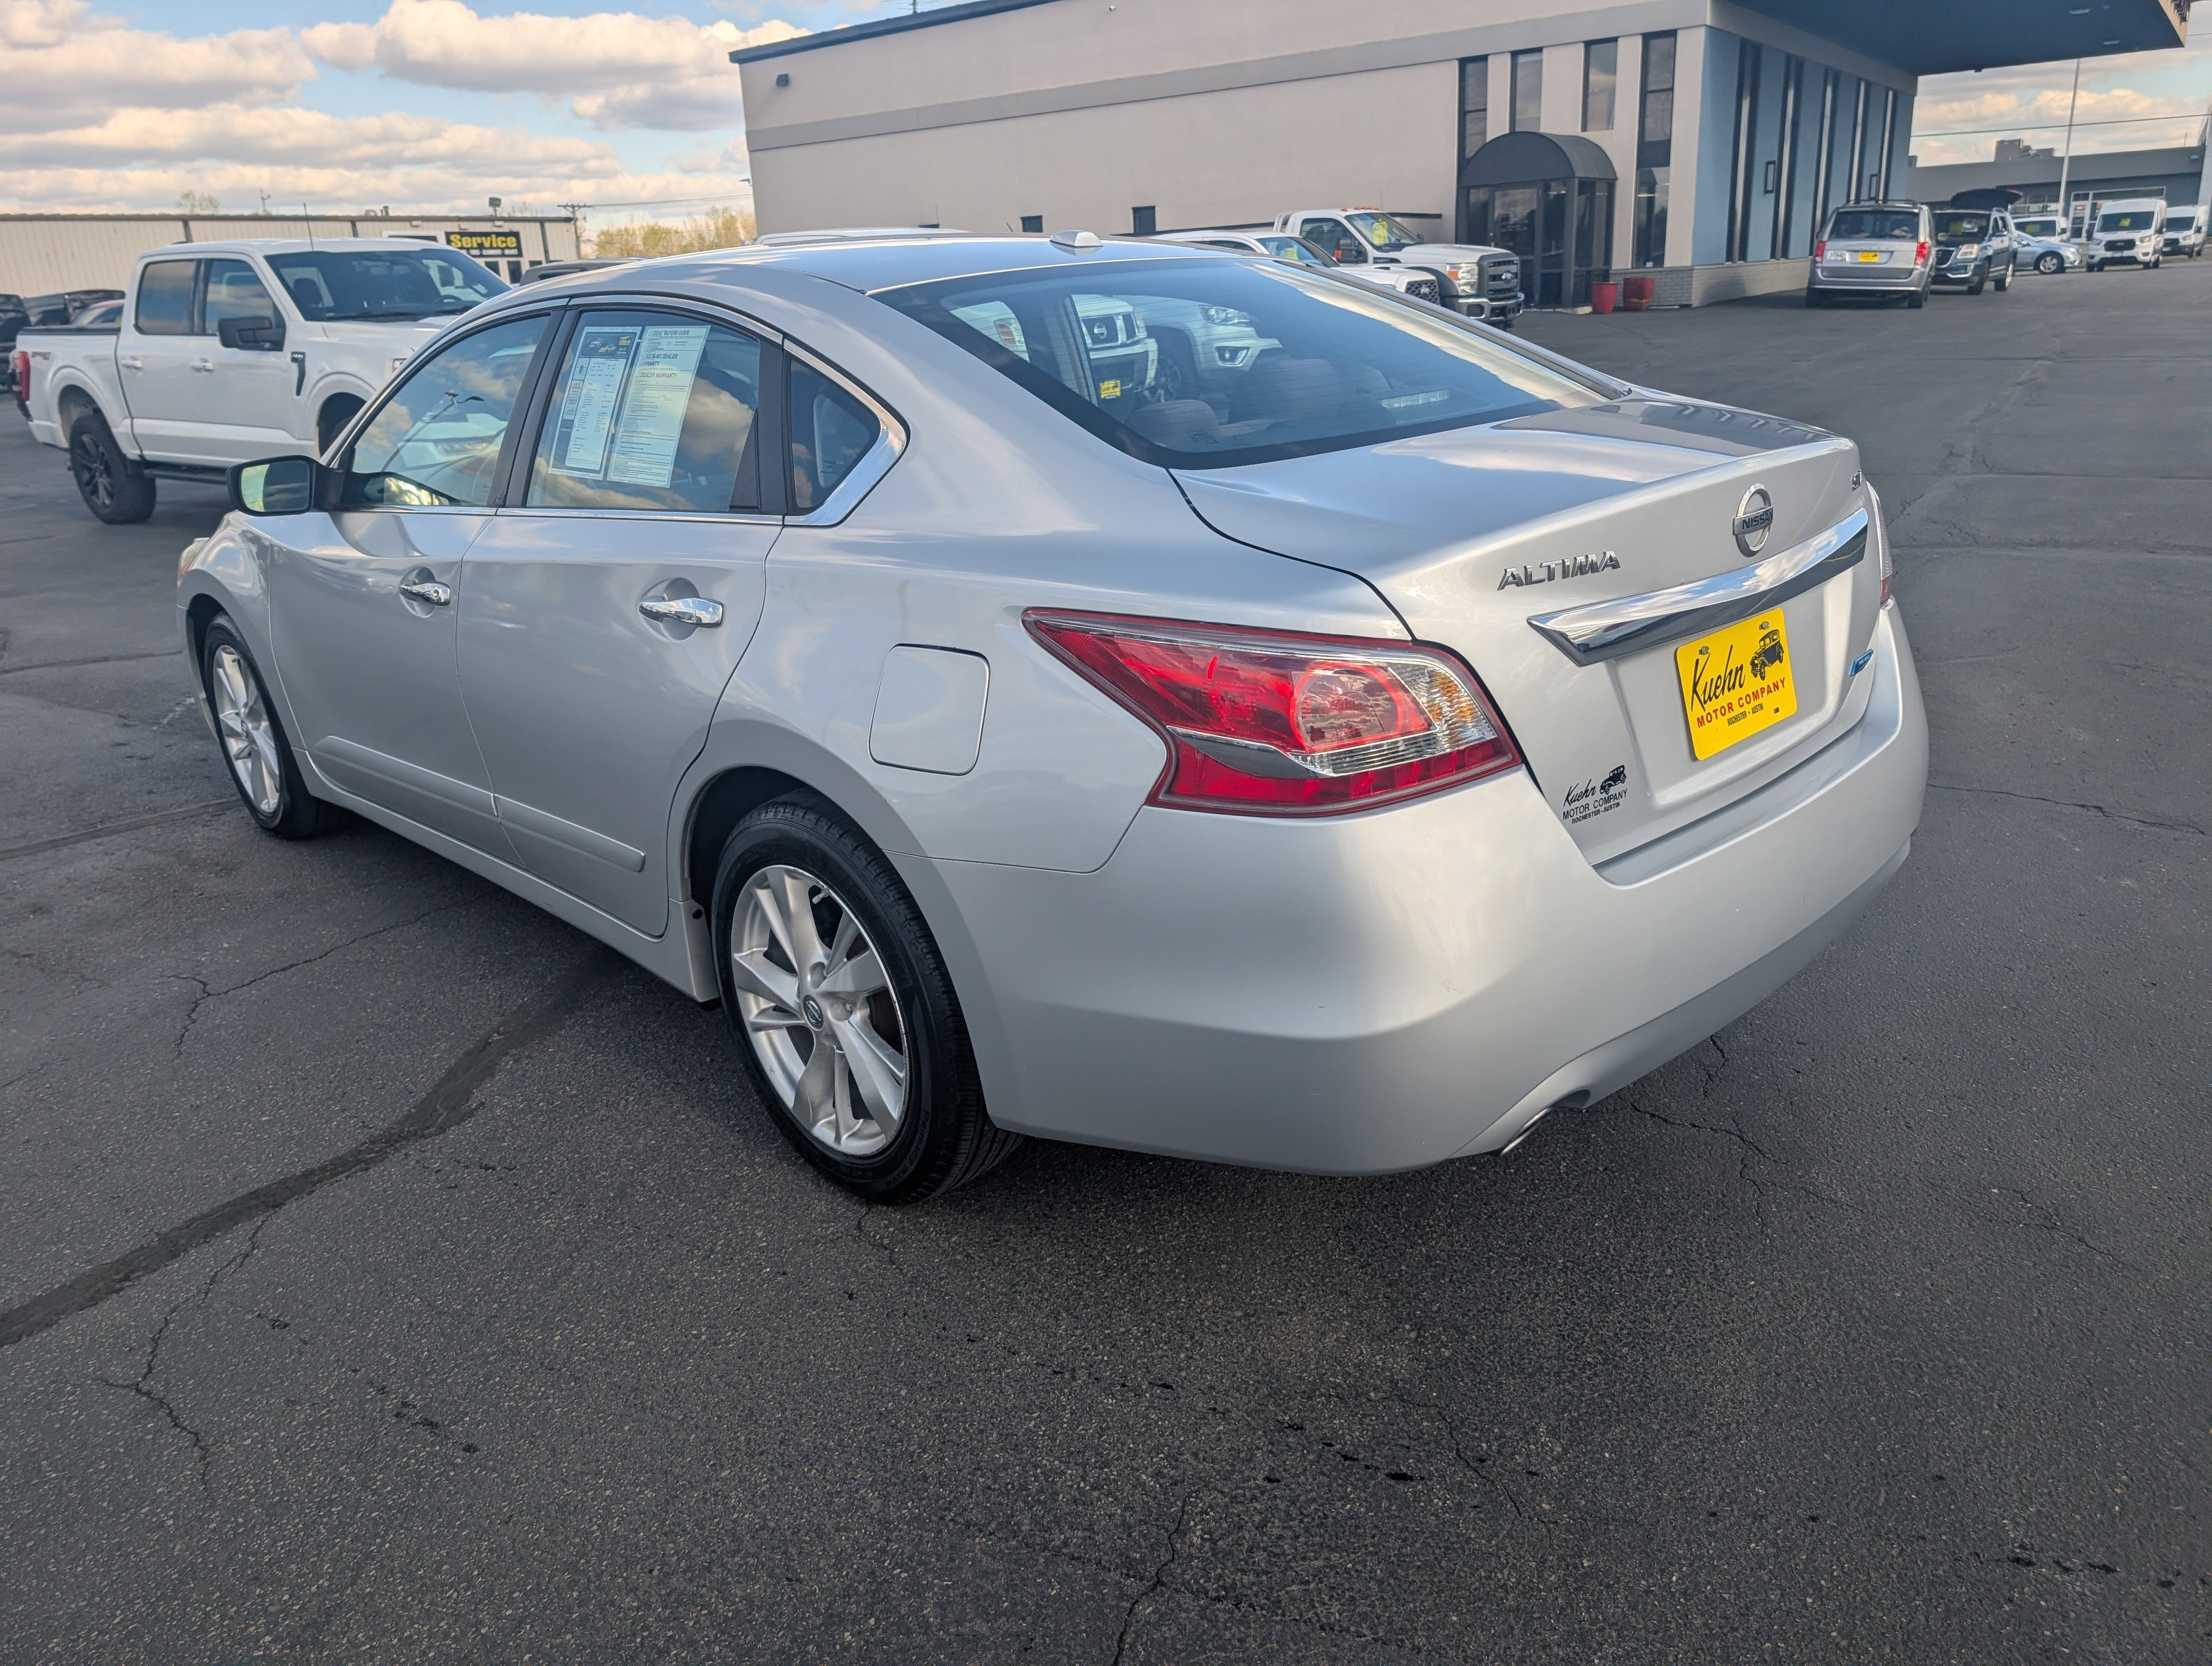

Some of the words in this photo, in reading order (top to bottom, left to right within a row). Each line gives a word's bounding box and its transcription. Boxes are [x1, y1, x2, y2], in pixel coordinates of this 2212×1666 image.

[449, 234, 517, 248] Service
[1741, 510, 1773, 530] NISSAN
[1497, 550, 1621, 591] ALTIMA
[1690, 644, 1746, 713] Kuehn
[1696, 702, 1734, 729] MOTOR
[1738, 677, 1786, 708] COMPANY
[1727, 710, 1748, 727] ROCHESTER
[1751, 702, 1764, 715] AUSTIN
[1562, 778, 1597, 808] Kuehn
[1562, 803, 1590, 821] MOTOR
[1593, 788, 1628, 809] COMPANY
